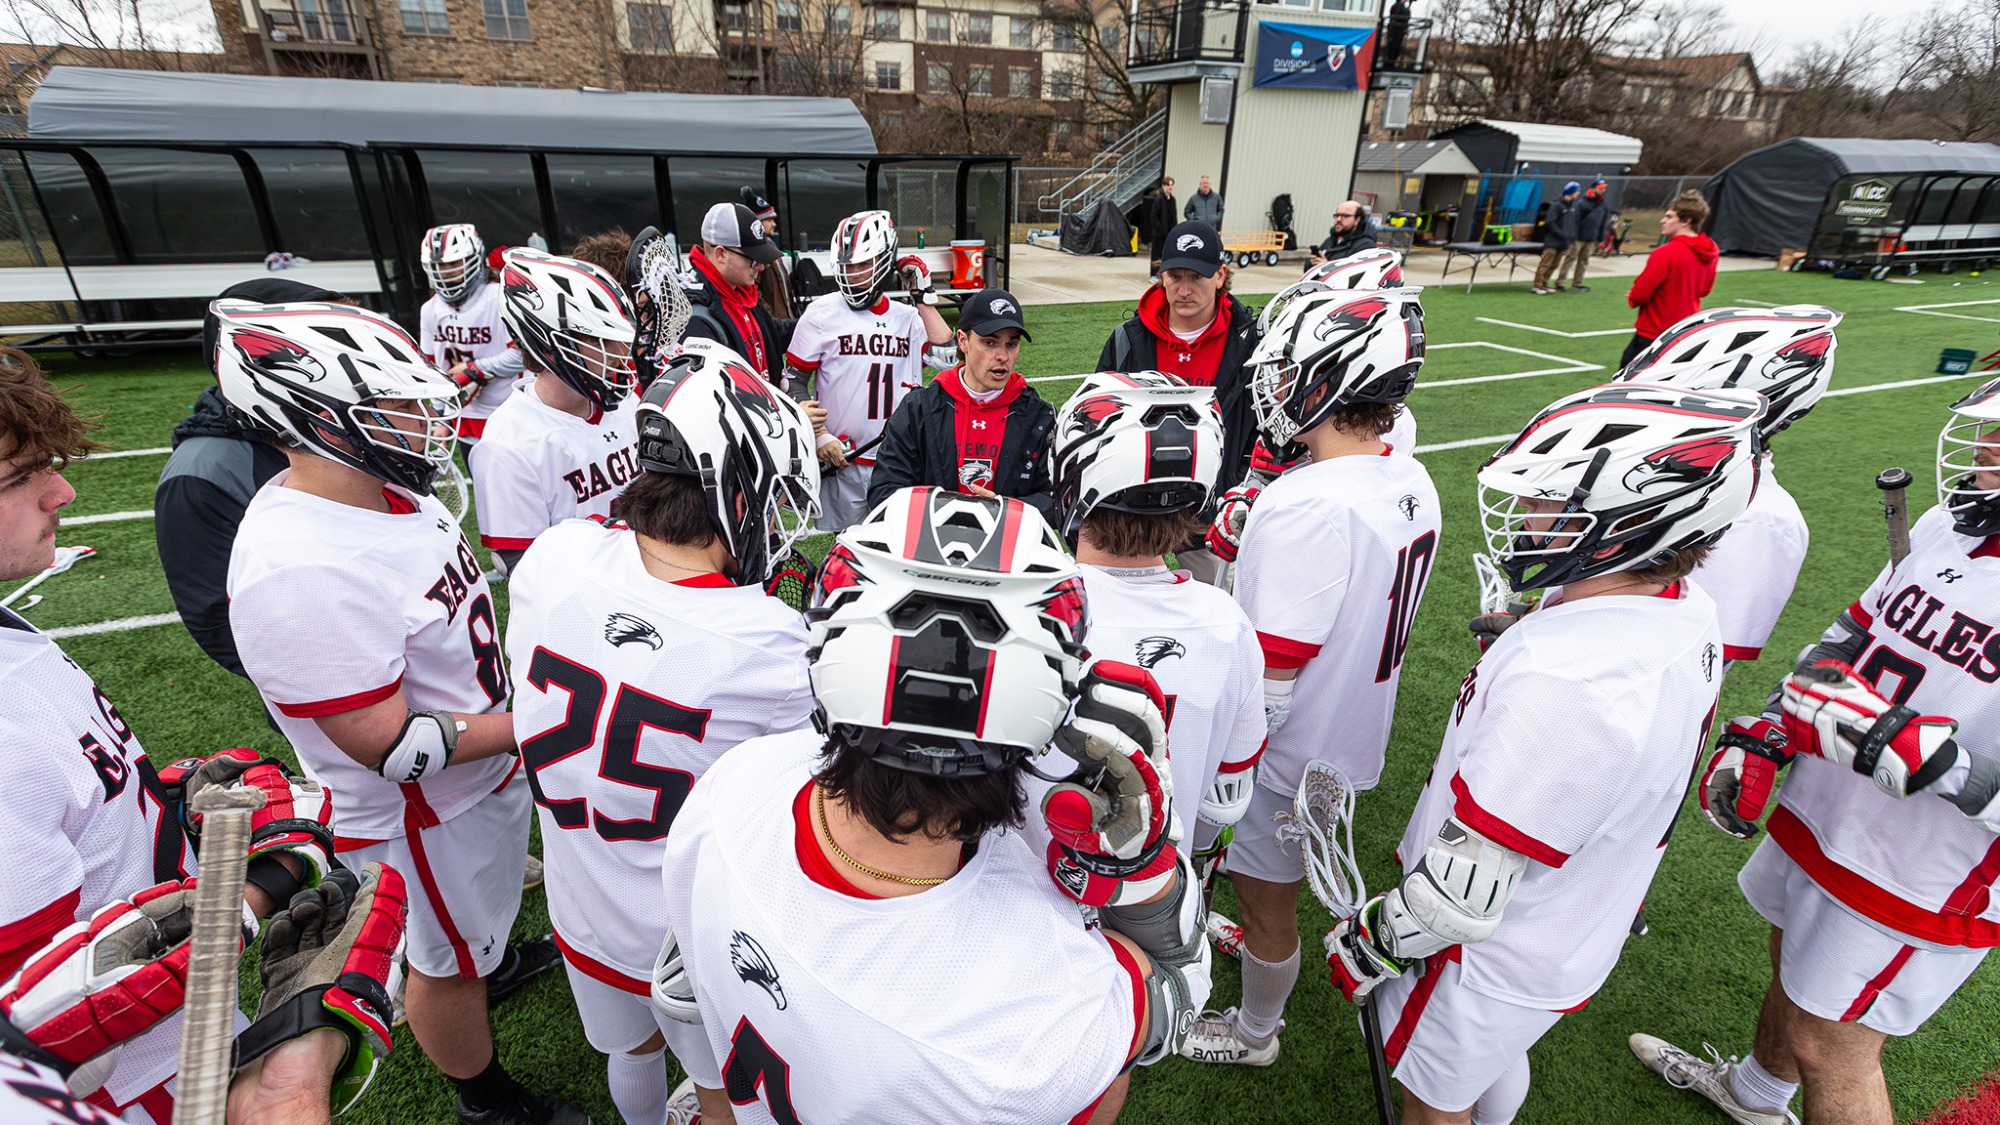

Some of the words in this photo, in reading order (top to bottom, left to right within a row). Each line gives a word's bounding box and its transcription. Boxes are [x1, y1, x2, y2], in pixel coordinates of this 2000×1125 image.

[838, 334, 911, 358] EAGLES
[867, 362, 894, 420] 11
[563, 441, 643, 504] EAGL
[902, 569, 1001, 587] cascade
[1374, 529, 1436, 683] 10
[520, 645, 712, 842] 25
